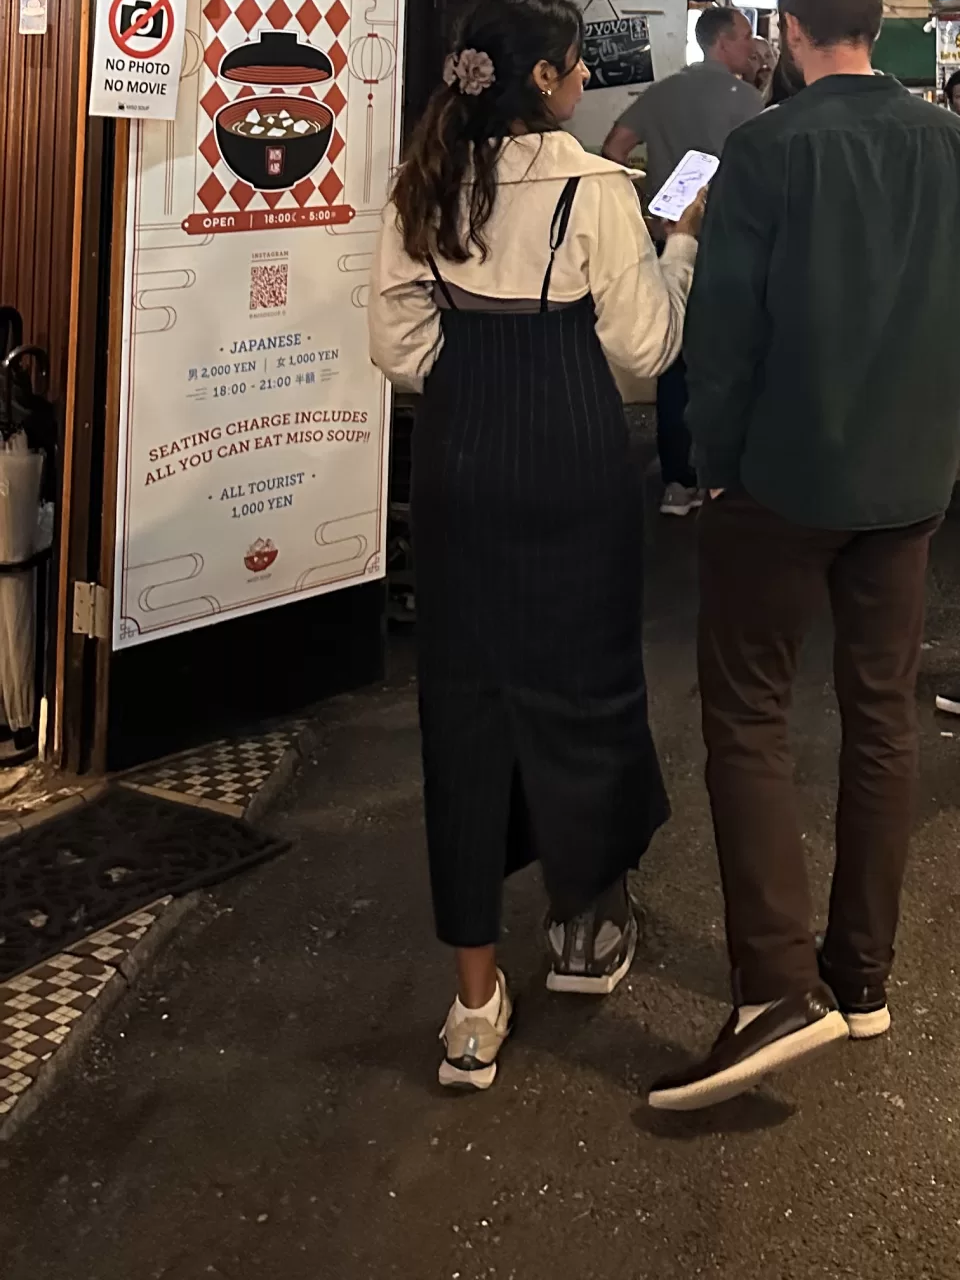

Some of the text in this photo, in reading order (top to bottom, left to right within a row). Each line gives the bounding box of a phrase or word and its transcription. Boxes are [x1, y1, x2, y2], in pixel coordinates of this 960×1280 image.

[105, 58, 171, 76] NO PHOTO
[104, 78, 168, 96] NO MOVIE
[202, 216, 236, 229] OPEN
[263, 212, 291, 225] 18:00
[309, 210, 331, 221] 5:00
[251, 250, 289, 259] INSTAGRAM
[230, 333, 302, 354] JAPANESE
[187, 349, 339, 381] 男 2,000 YEN 女 1,000 YEN
[213, 382, 247, 398] 18:00
[259, 376, 292, 391] 21:00
[149, 410, 369, 463] SEATING CHARGE INCLUDES
[145, 429, 371, 486] ALL YOU CAN EAT MISO SOUP!!
[220, 472, 305, 501] ALL TOURIST
[231, 494, 294, 519] 1,000 YEN
